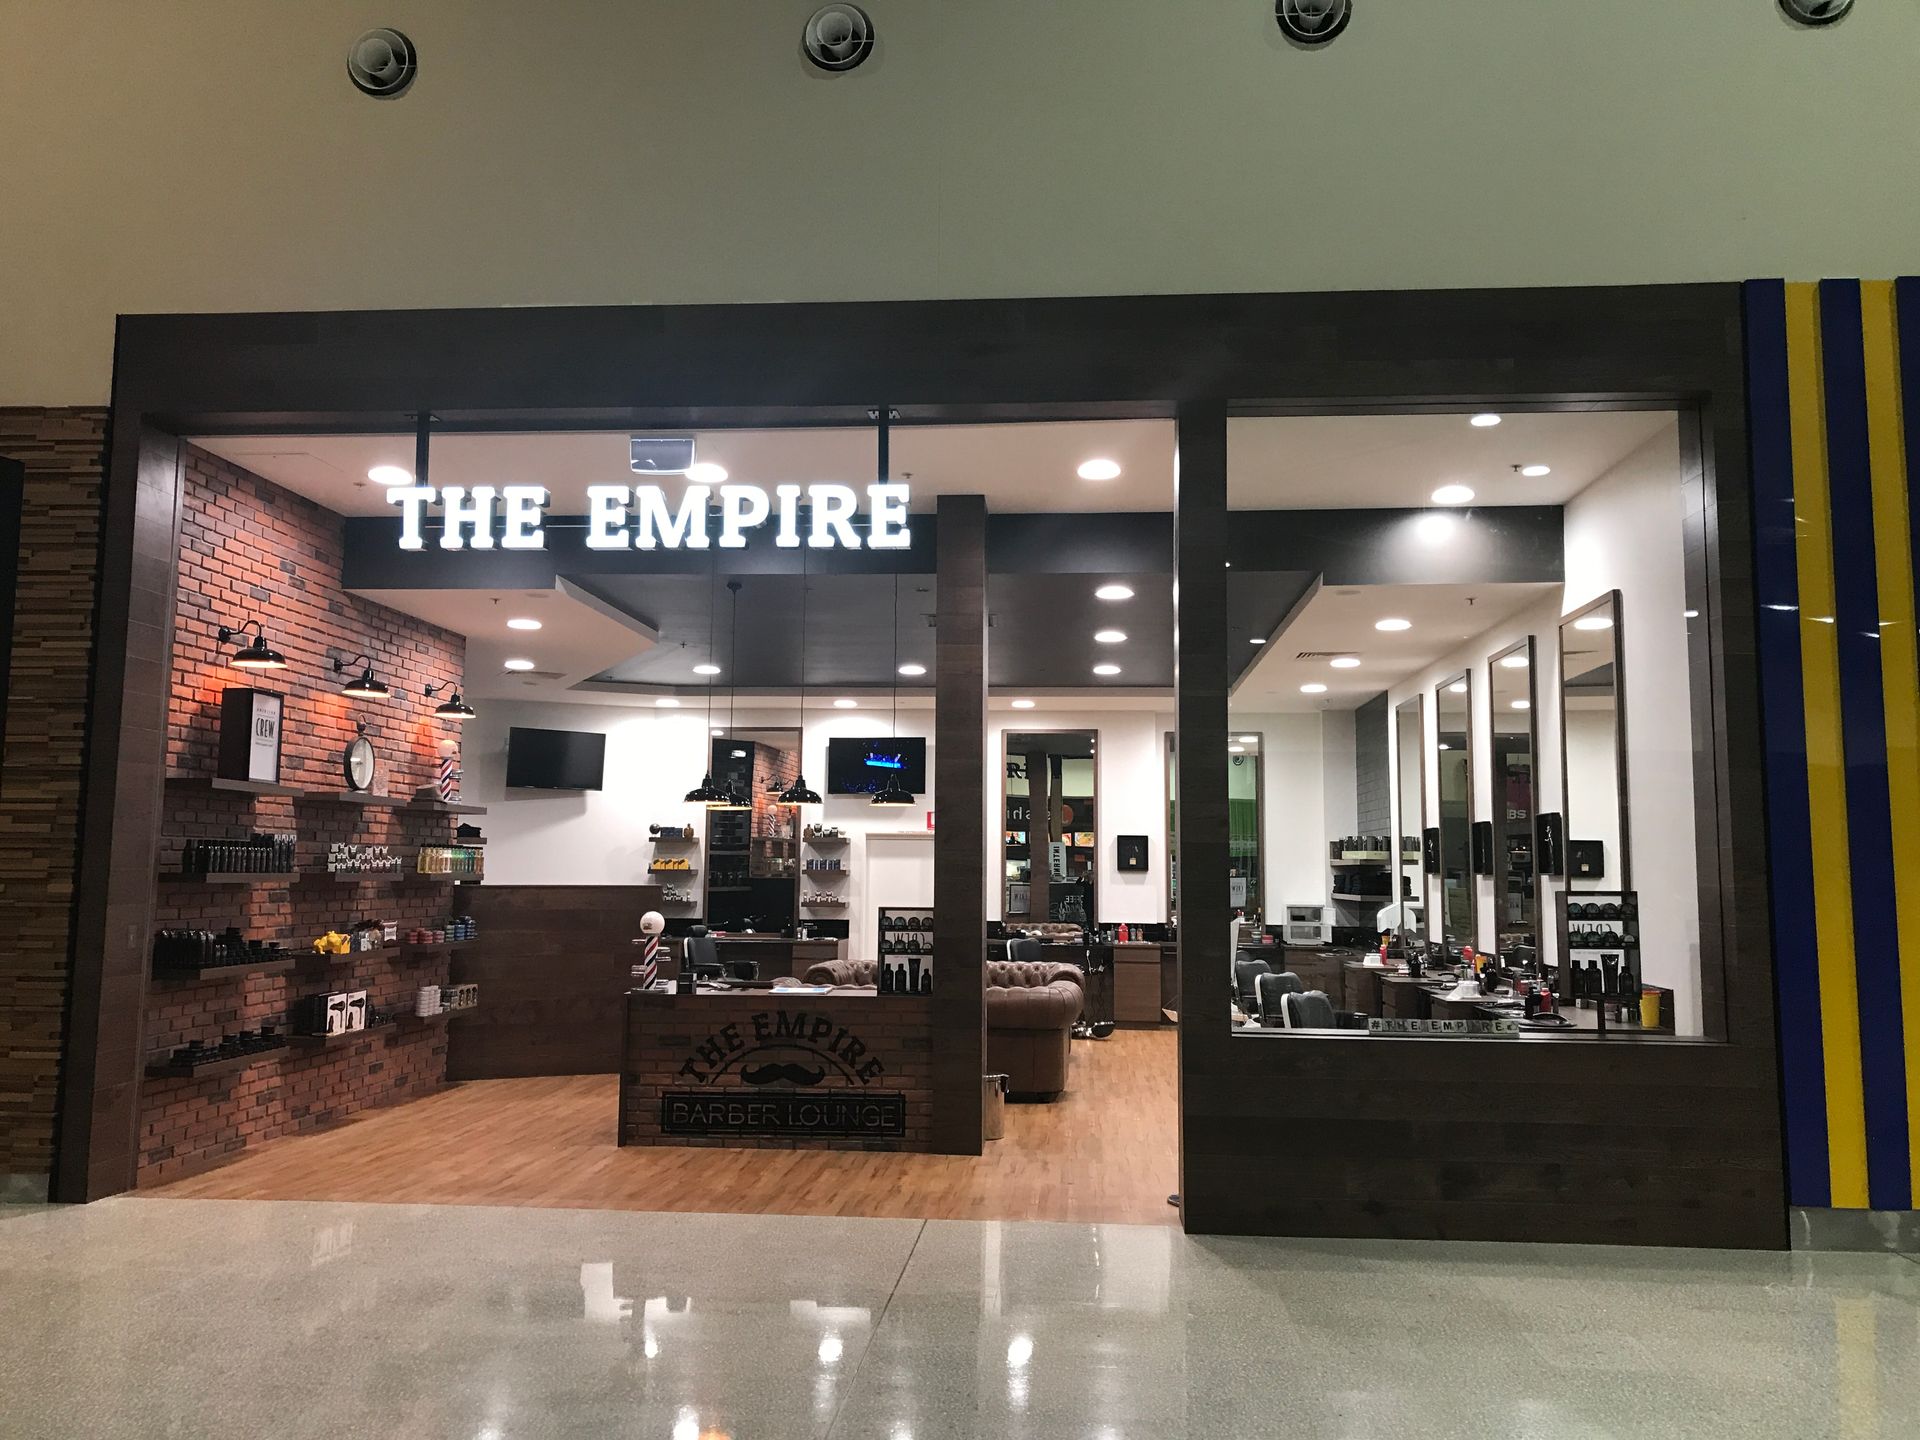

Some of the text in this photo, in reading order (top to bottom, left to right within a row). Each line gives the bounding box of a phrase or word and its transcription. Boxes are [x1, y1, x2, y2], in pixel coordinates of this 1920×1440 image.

[386, 484, 911, 551] THE EMPIRE
[255, 717, 275, 738] CREW
[678, 1010, 885, 1085] THE EMPIRE
[672, 1103, 896, 1127] BARBER LOUNGE
